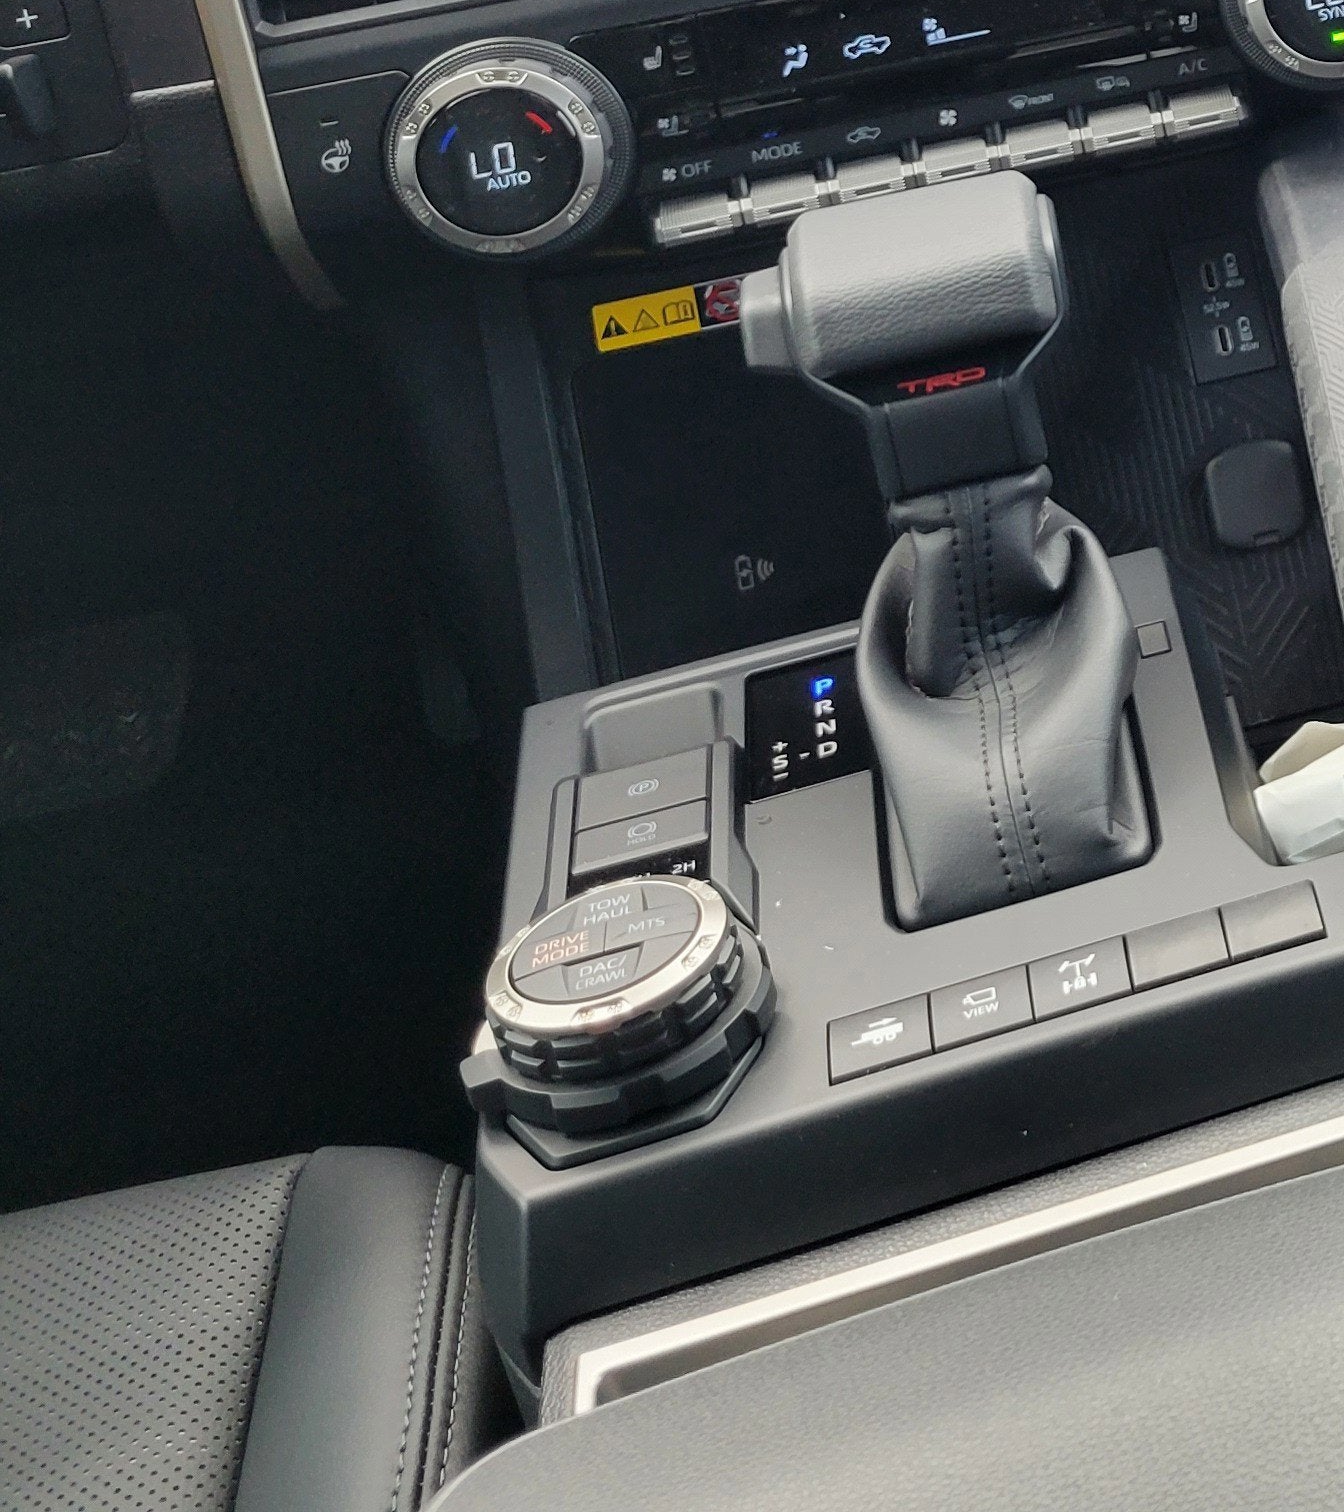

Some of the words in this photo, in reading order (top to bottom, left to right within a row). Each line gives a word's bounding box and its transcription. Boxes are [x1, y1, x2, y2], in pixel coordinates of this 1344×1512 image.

[1179, 58, 1208, 76] A/C
[751, 142, 803, 164] MODE
[681, 160, 713, 178] OFF
[486, 170, 532, 192] AUTO
[896, 366, 987, 394] TRD
[814, 677, 834, 697] P
[814, 699, 836, 718] R
[815, 718, 837, 738] N
[816, 740, 838, 760] D
[771, 753, 789, 772] S
[627, 834, 657, 847] HOLD
[671, 859, 696, 876] 2H
[588, 893, 631, 912] TOW
[583, 905, 633, 926] HAUL
[627, 916, 667, 935] MTS
[533, 930, 590, 956] DRIVE
[531, 941, 590, 968] MODE
[579, 954, 628, 978] DAC/
[575, 969, 629, 991] CRAWL
[962, 1001, 1000, 1019] VIEW
